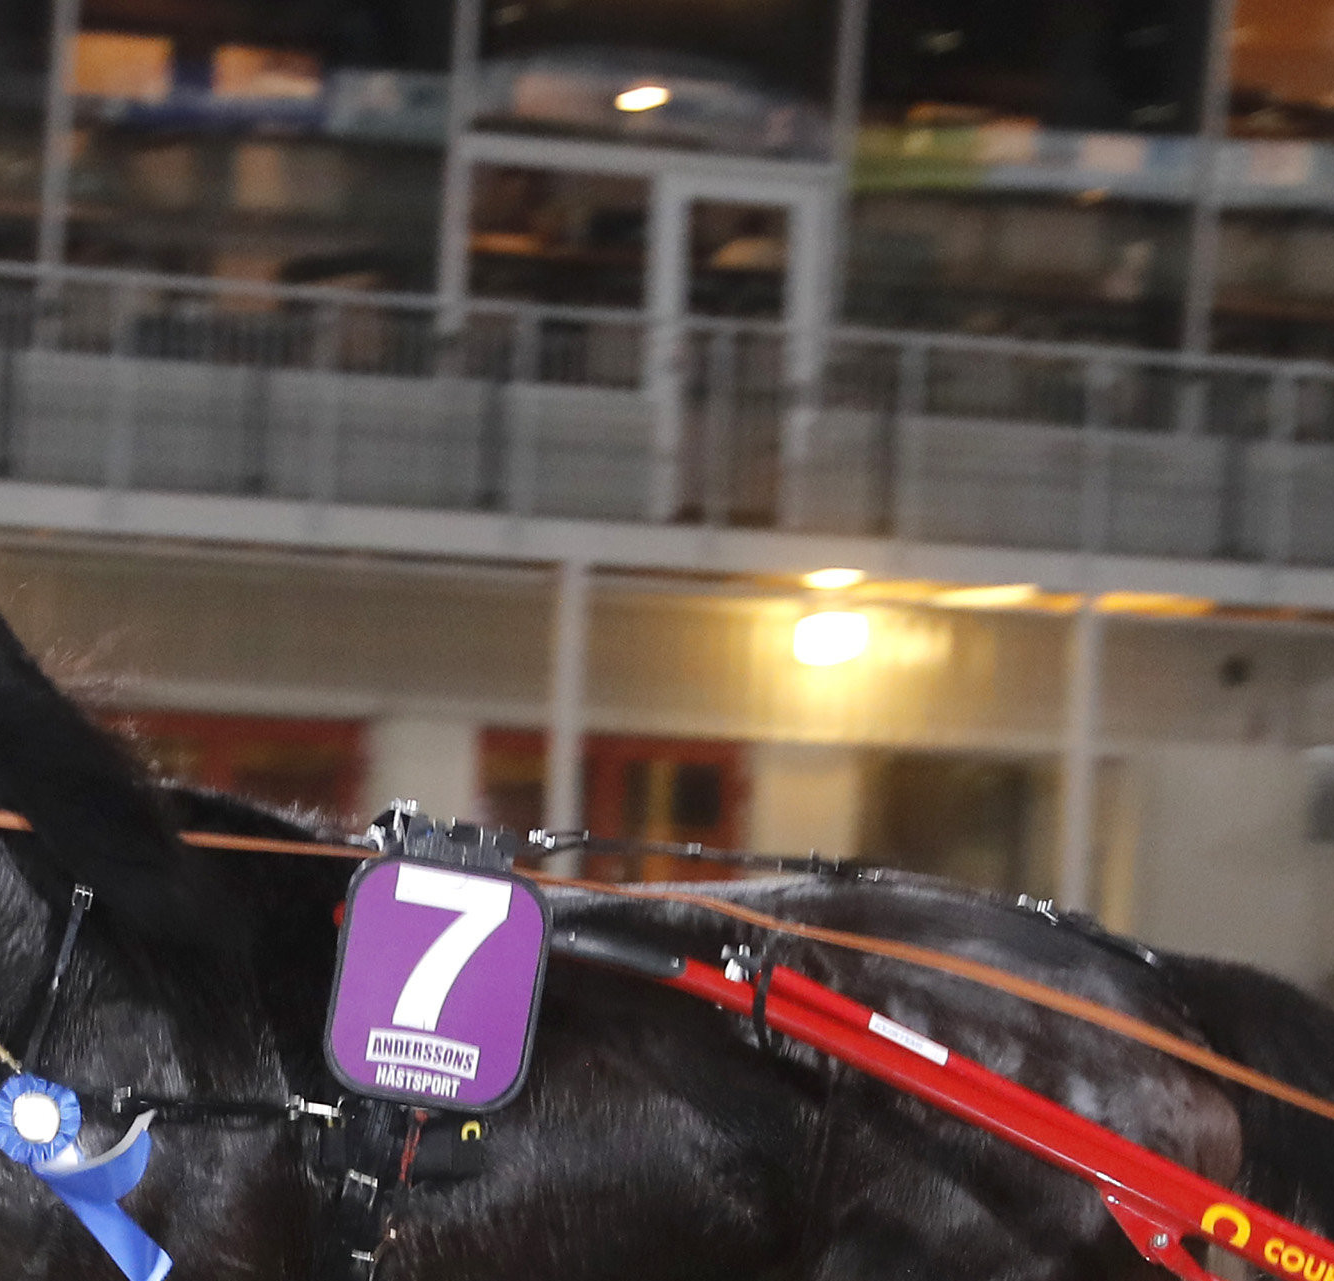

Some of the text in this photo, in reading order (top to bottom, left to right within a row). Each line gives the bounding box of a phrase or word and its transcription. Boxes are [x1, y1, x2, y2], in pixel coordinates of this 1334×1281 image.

[392, 863, 512, 1031] 7
[372, 1036, 475, 1070] ANDERSSONS
[375, 1065, 461, 1098] HÄSTSPORT
